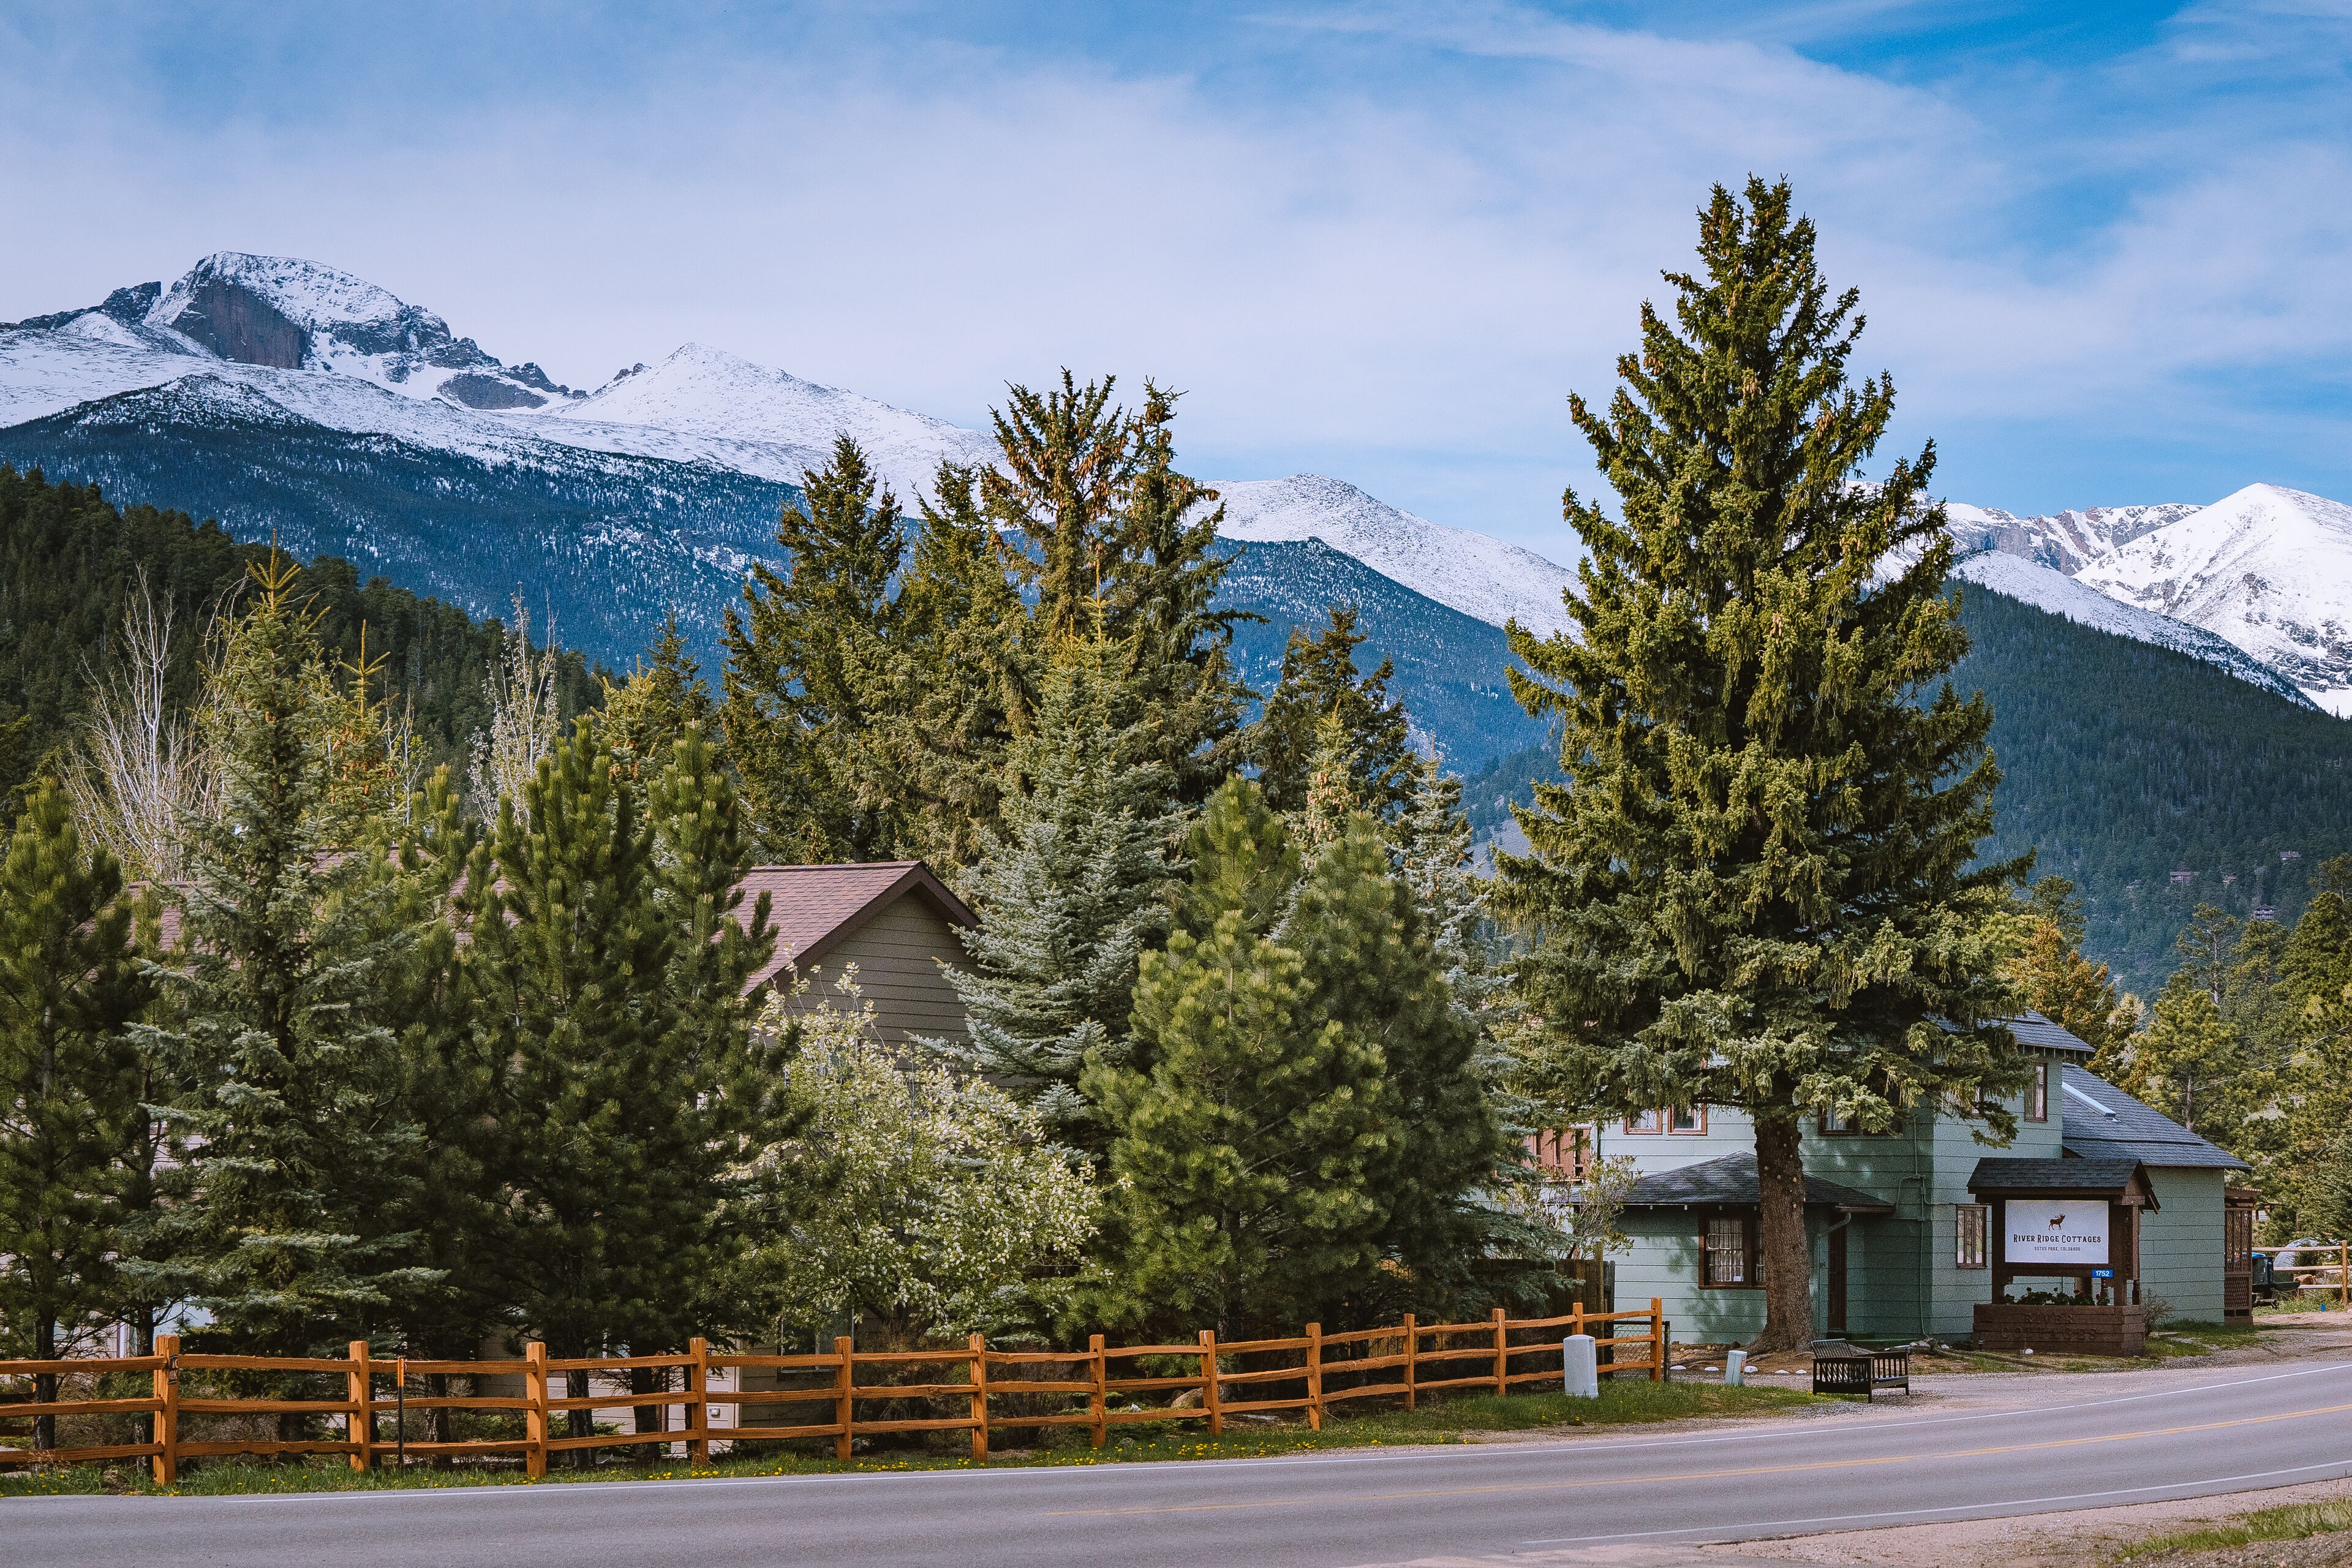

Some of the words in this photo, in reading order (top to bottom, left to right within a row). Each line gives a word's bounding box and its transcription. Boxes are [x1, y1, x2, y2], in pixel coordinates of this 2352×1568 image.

[2013, 1234, 2035, 1243] RIVER
[2037, 1234, 2059, 1243] RIDGE
[2062, 1234, 2101, 1243] COTTAGES
